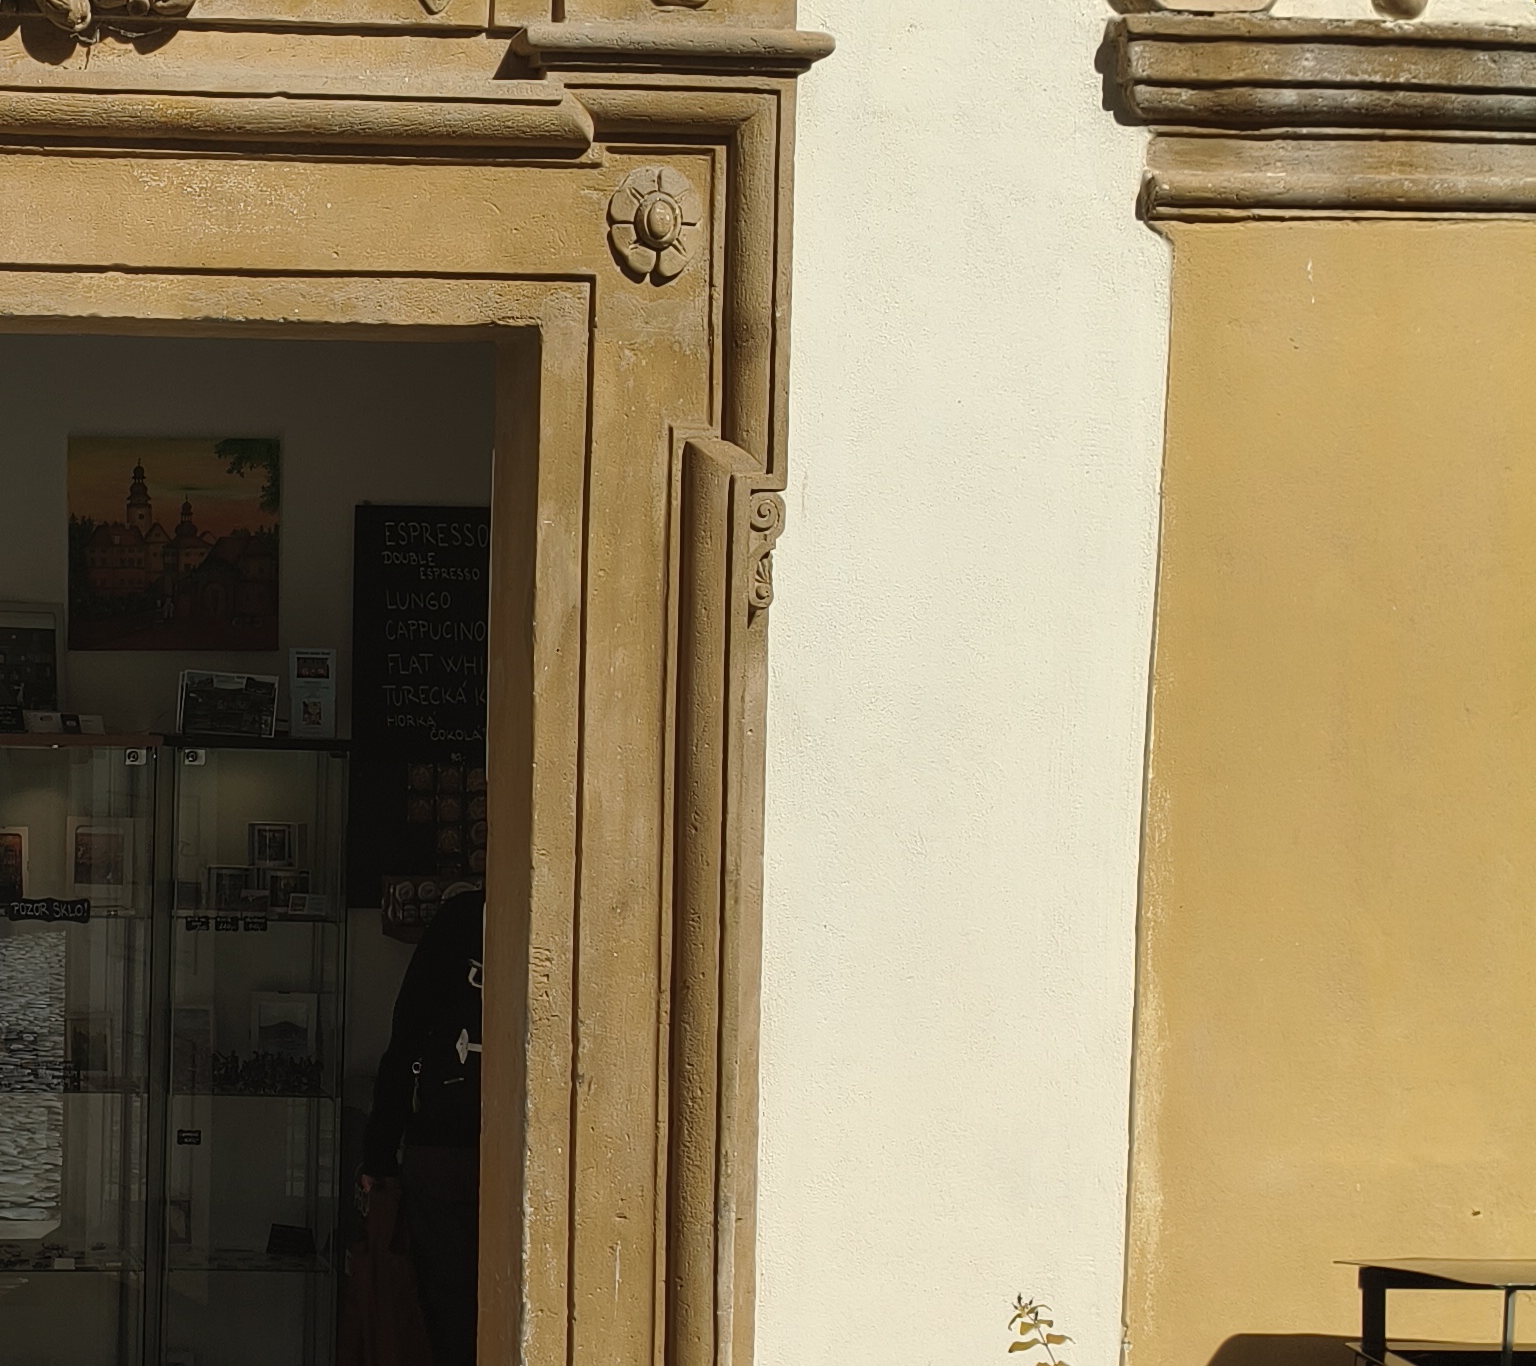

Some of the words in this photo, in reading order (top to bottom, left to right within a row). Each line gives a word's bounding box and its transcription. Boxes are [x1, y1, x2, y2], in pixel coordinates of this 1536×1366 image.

[383, 521, 489, 548] ESPRESSO
[382, 551, 436, 566] DOUBLE
[419, 567, 480, 581] ESPRESSO
[386, 589, 451, 610] LUNGO
[385, 619, 486, 642] CAPPUCINO
[387, 653, 433, 675] FLAT
[382, 679, 468, 707] TURECKÁ
[387, 710, 437, 728] HORKÁ
[10, 901, 50, 917] POZOR
[52, 900, 88, 919] SKLO!
